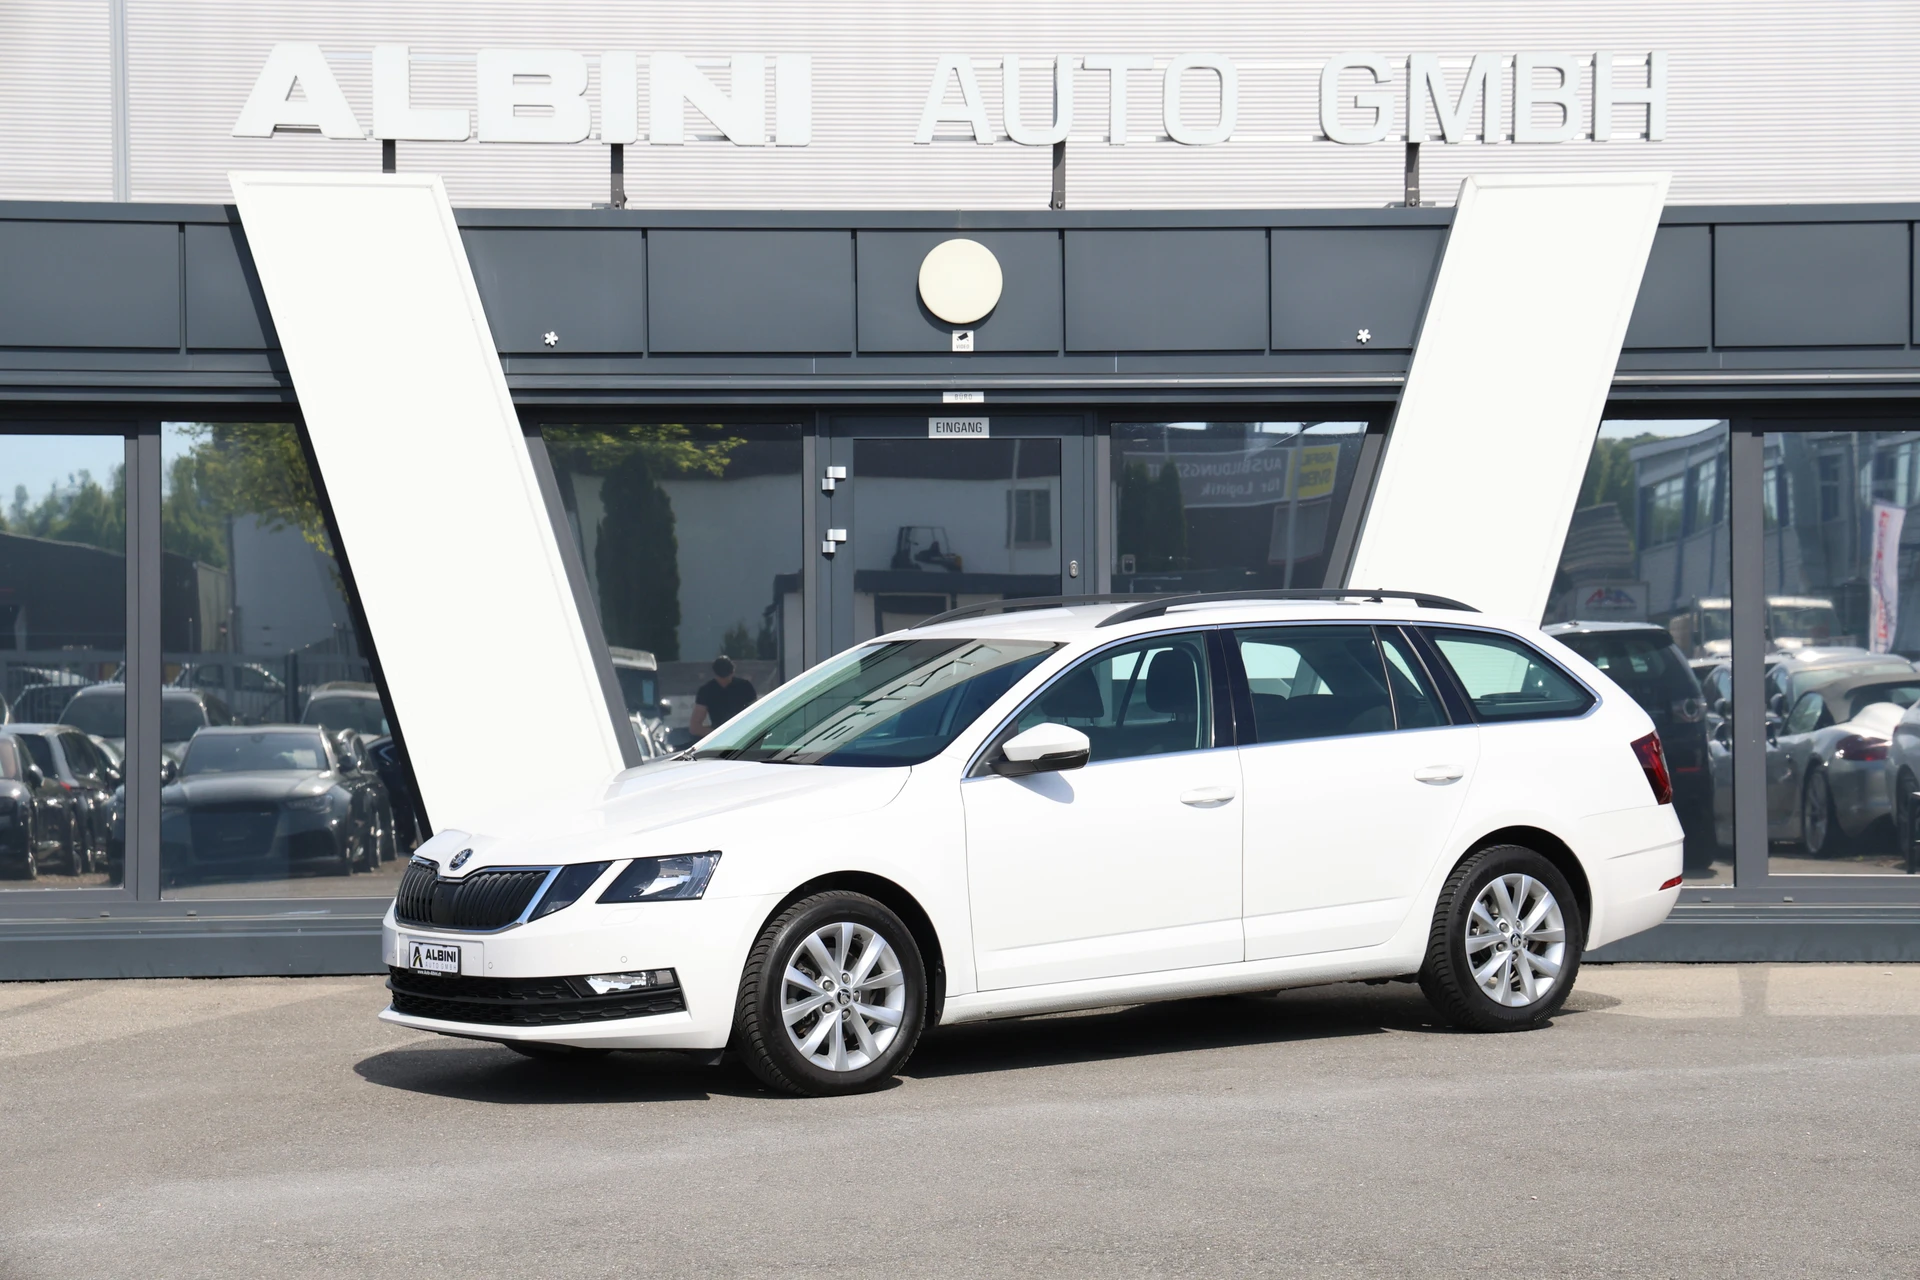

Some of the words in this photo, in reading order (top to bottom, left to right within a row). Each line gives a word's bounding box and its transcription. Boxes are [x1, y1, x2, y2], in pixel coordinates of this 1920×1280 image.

[231, 41, 812, 148] ALBINI
[913, 52, 1238, 147] AUTO
[1319, 50, 1669, 145] GMBH
[936, 421, 983, 433] EINGANG
[425, 948, 456, 962] ALBINI
[425, 961, 439, 970] AUTO
